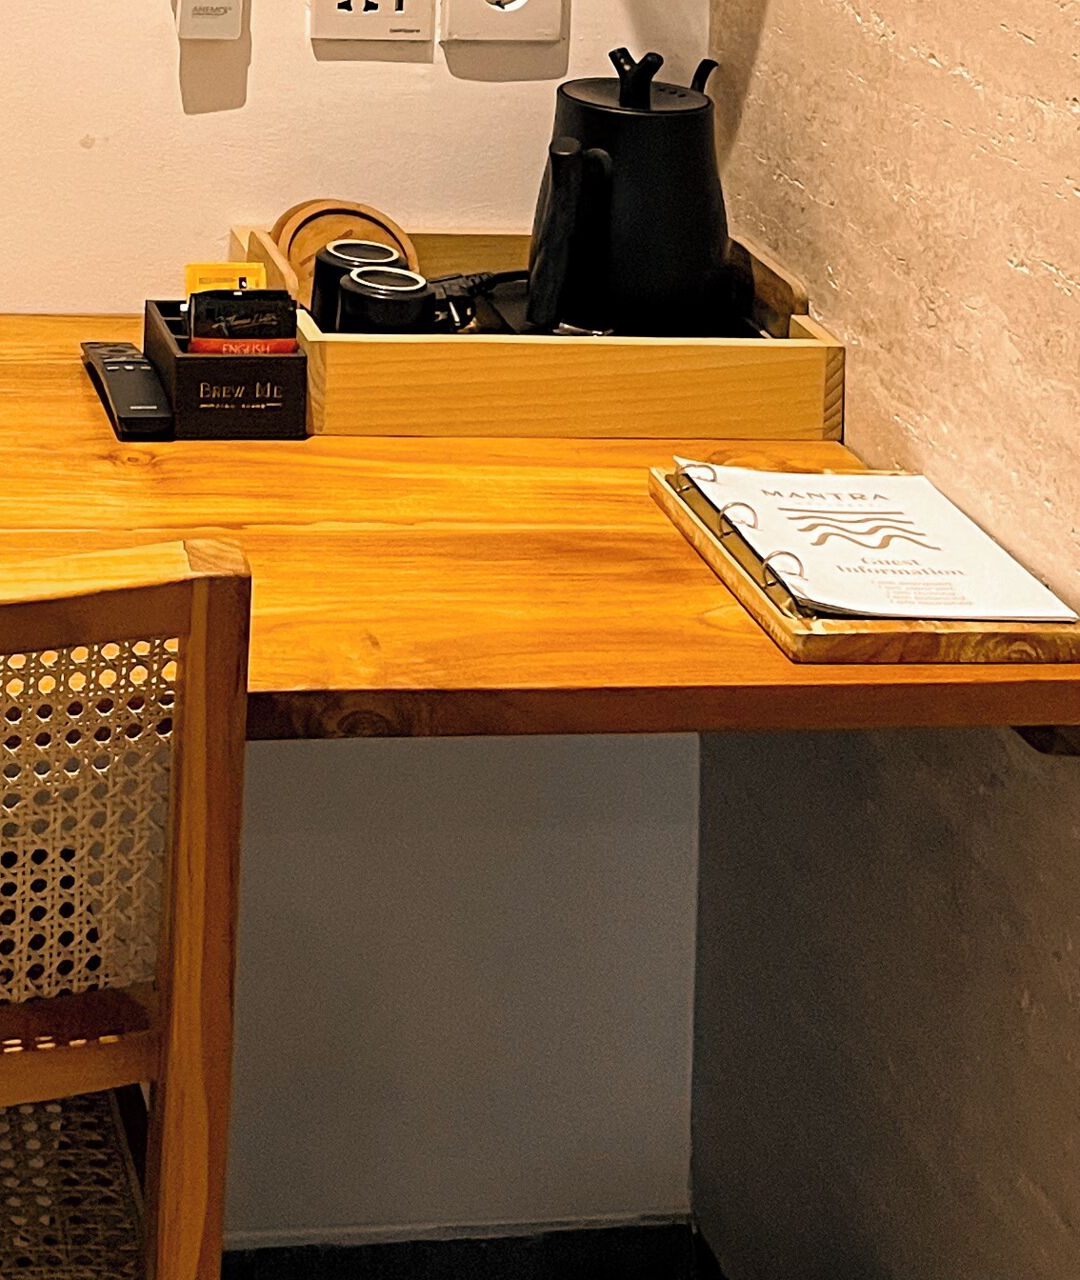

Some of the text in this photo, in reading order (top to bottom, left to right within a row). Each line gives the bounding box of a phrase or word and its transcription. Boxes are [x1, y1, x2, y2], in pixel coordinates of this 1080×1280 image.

[222, 343, 271, 354] ENGLISH
[761, 489, 890, 501] MANTRA
[860, 556, 922, 566] Guest
[834, 564, 968, 577] Information
